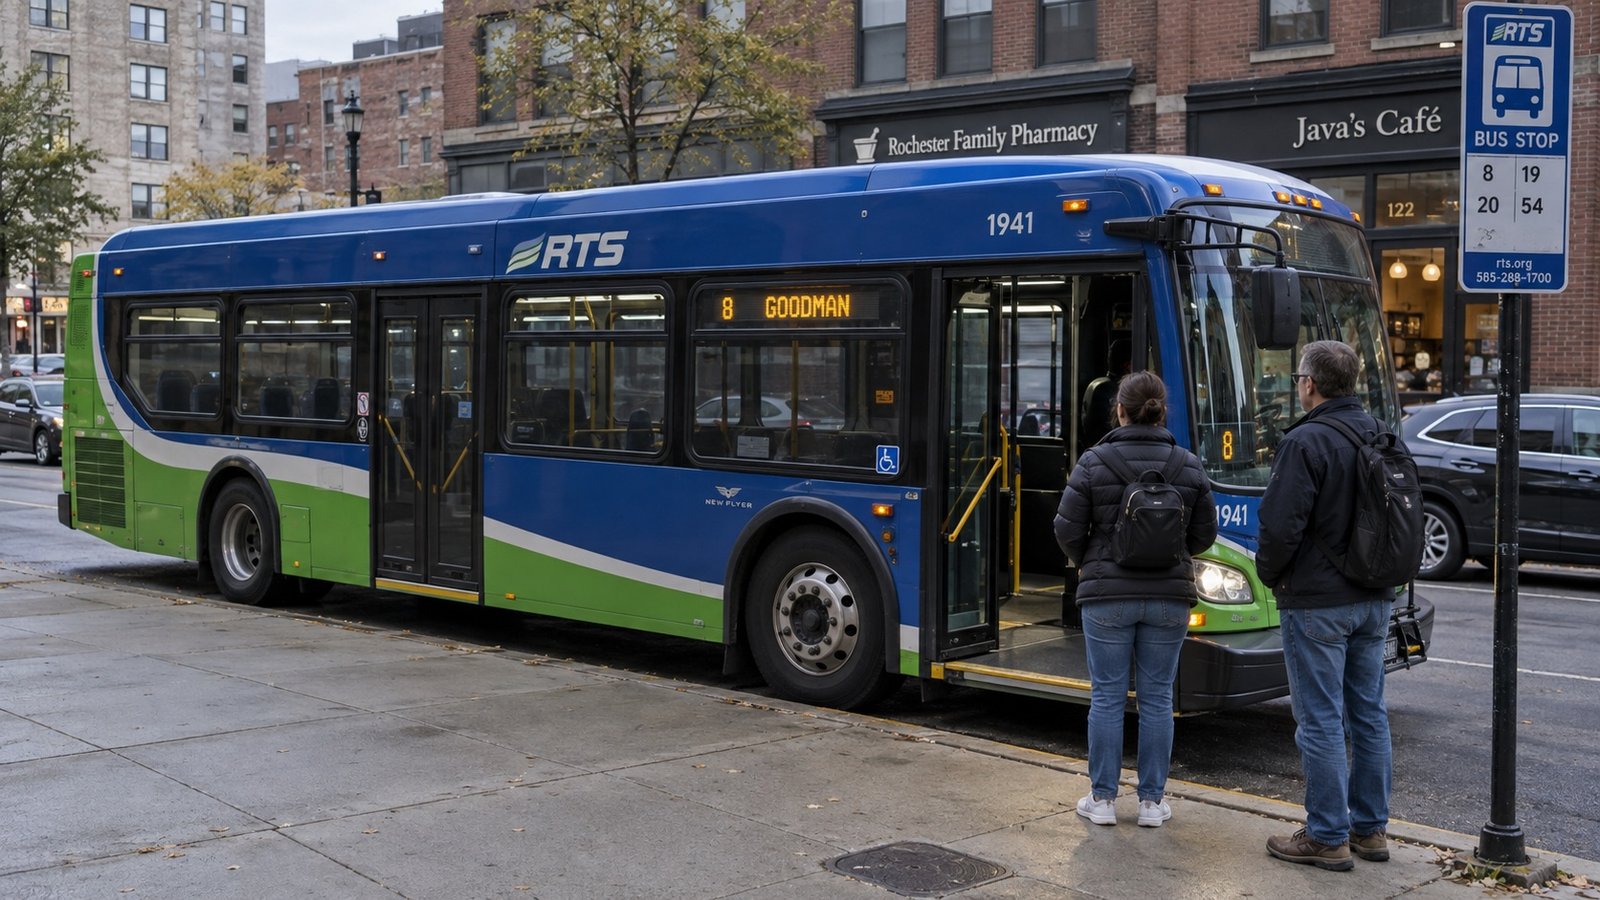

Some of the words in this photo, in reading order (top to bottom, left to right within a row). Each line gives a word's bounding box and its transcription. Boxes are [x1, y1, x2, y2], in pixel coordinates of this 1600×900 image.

[1503, 22, 1545, 43] RTS
[1293, 112, 1366, 149] Java's
[1376, 106, 1442, 136] Café
[888, 134, 950, 156] Rochester
[953, 125, 1007, 153] Family
[1010, 122, 1098, 146] Pharmacy
[1474, 130, 1508, 147] BUS
[1515, 131, 1559, 149] STOP
[1483, 164, 1494, 182] 8
[1521, 165, 1541, 183] 19
[1387, 202, 1415, 218] 122
[1477, 196, 1499, 214] 20
[1521, 197, 1544, 214] 54
[987, 211, 1034, 236] 1941
[540, 230, 630, 269] RTS
[1496, 258, 1533, 271] rts.org
[722, 296, 734, 320] 8
[765, 294, 850, 319] GOODMAN
[1222, 430, 1233, 460] 8
[705, 498, 724, 506] NEW
[725, 500, 753, 509] FLYER
[1215, 503, 1248, 527] 1941
